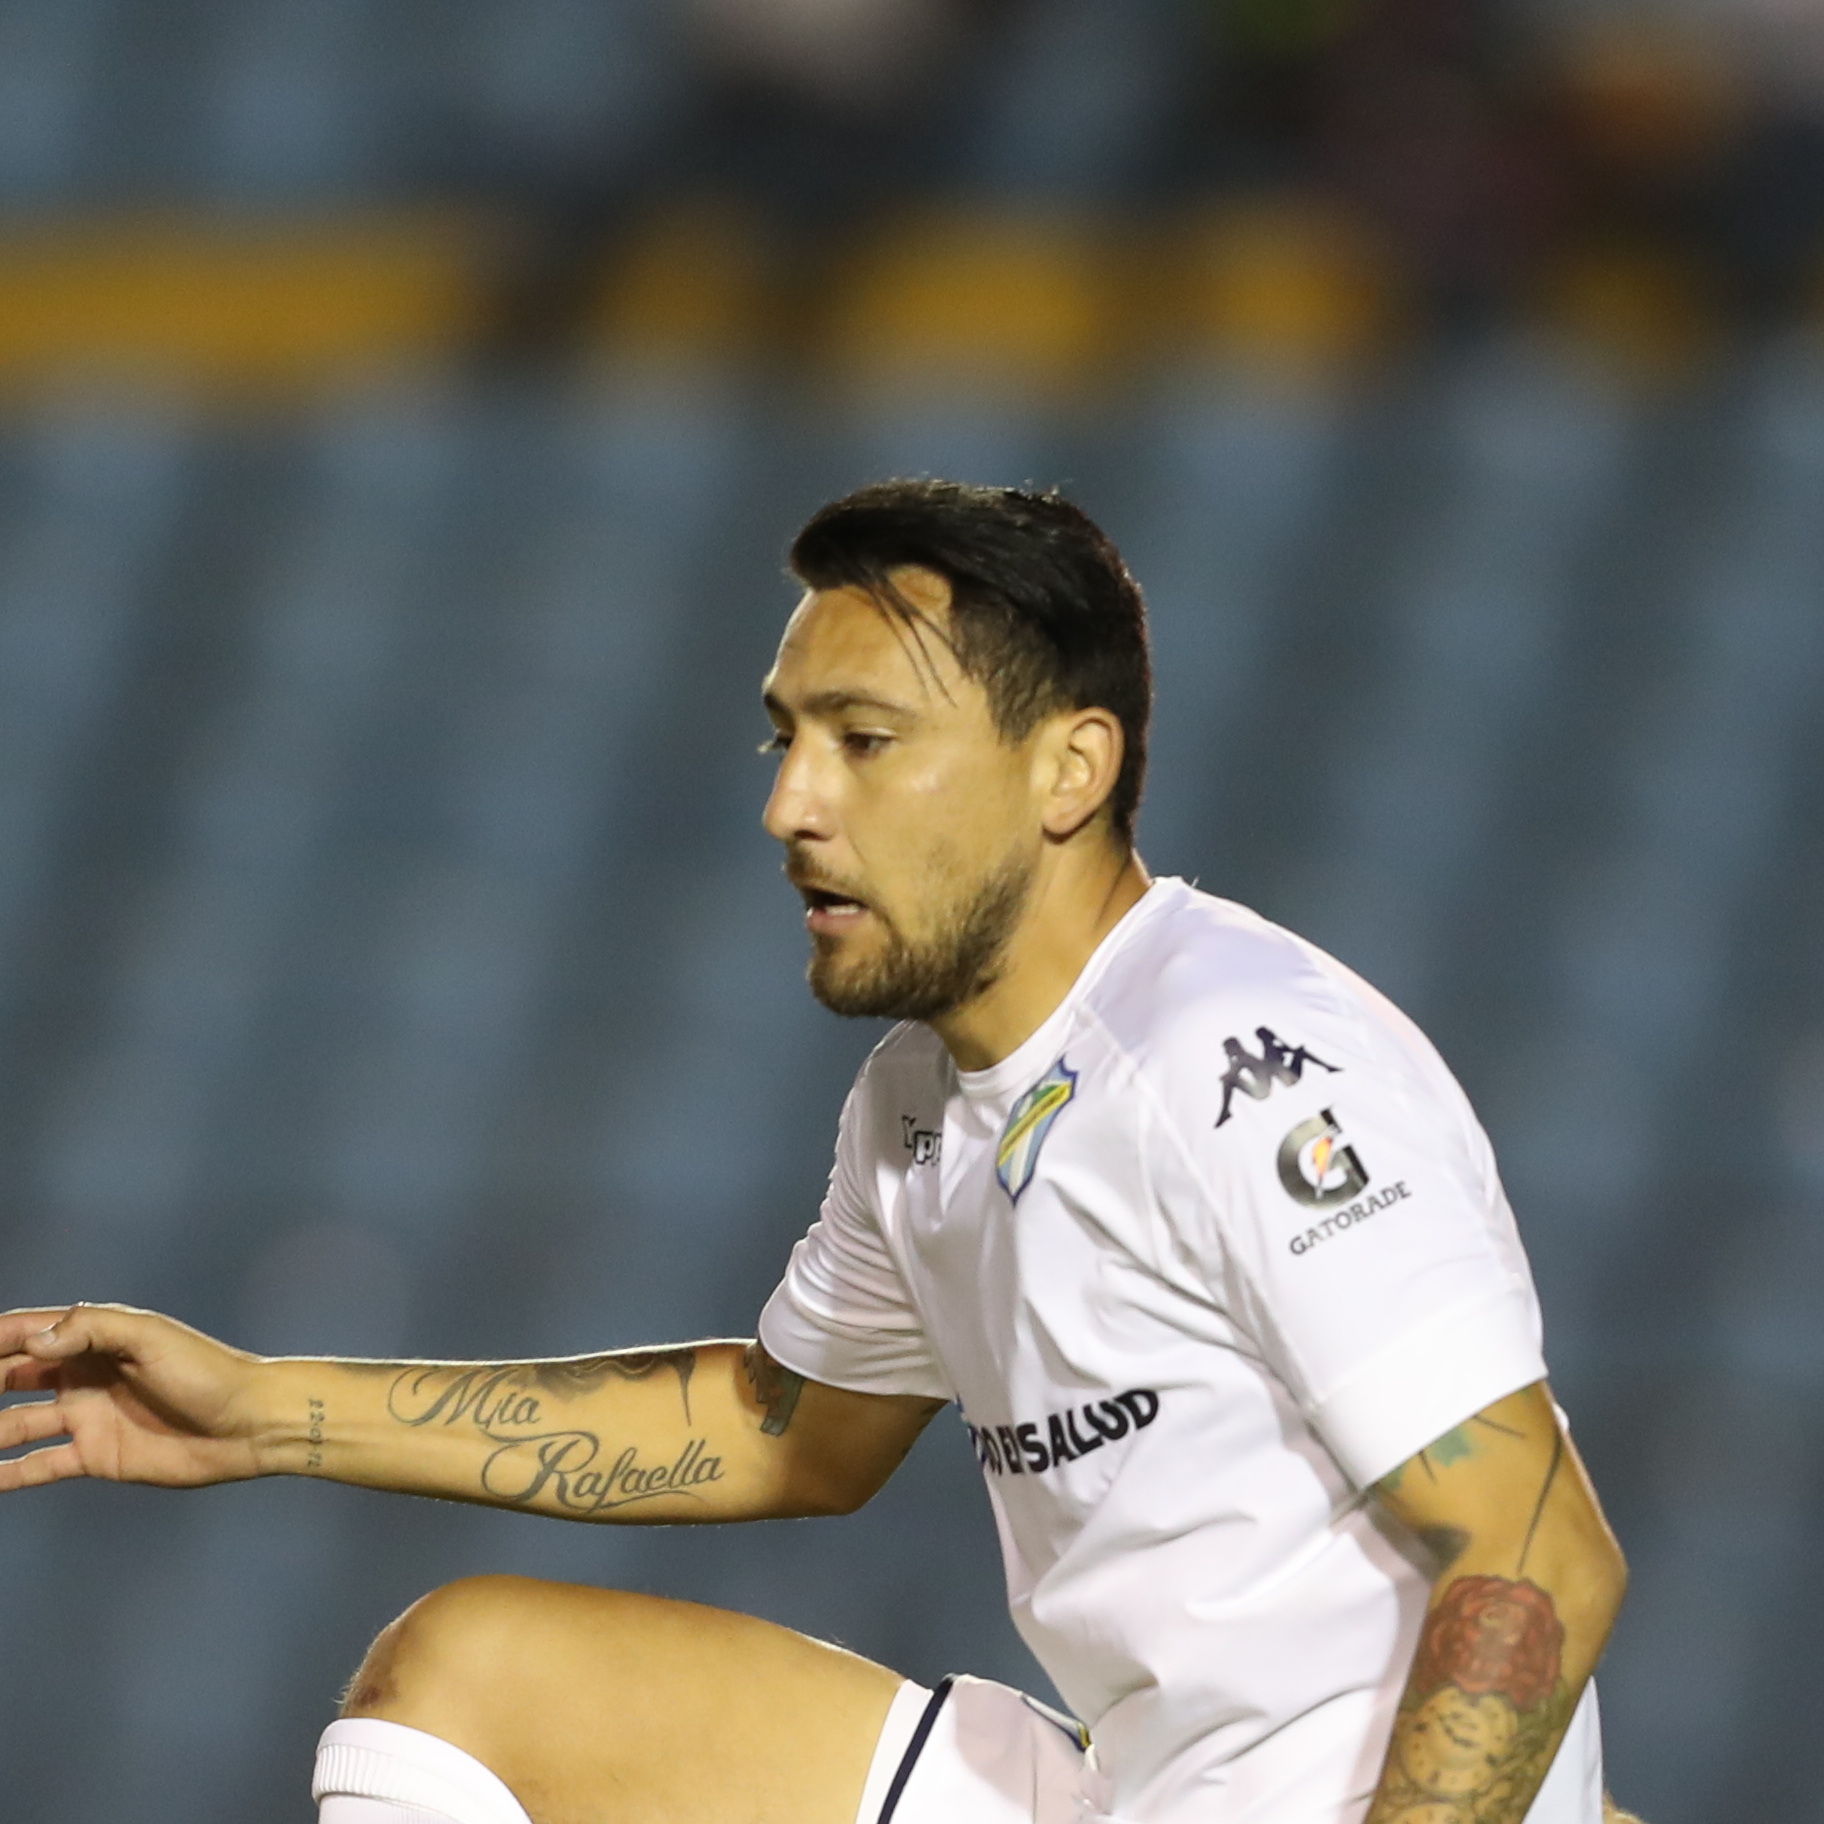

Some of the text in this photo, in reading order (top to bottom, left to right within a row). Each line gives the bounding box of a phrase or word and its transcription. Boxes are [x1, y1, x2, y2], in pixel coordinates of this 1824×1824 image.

[1289, 1181, 1411, 1256] GATORADE
[388, 1366, 540, 1428] Mia
[1016, 1388, 1160, 1474] SALUD
[480, 1431, 726, 1514] Rafaella
